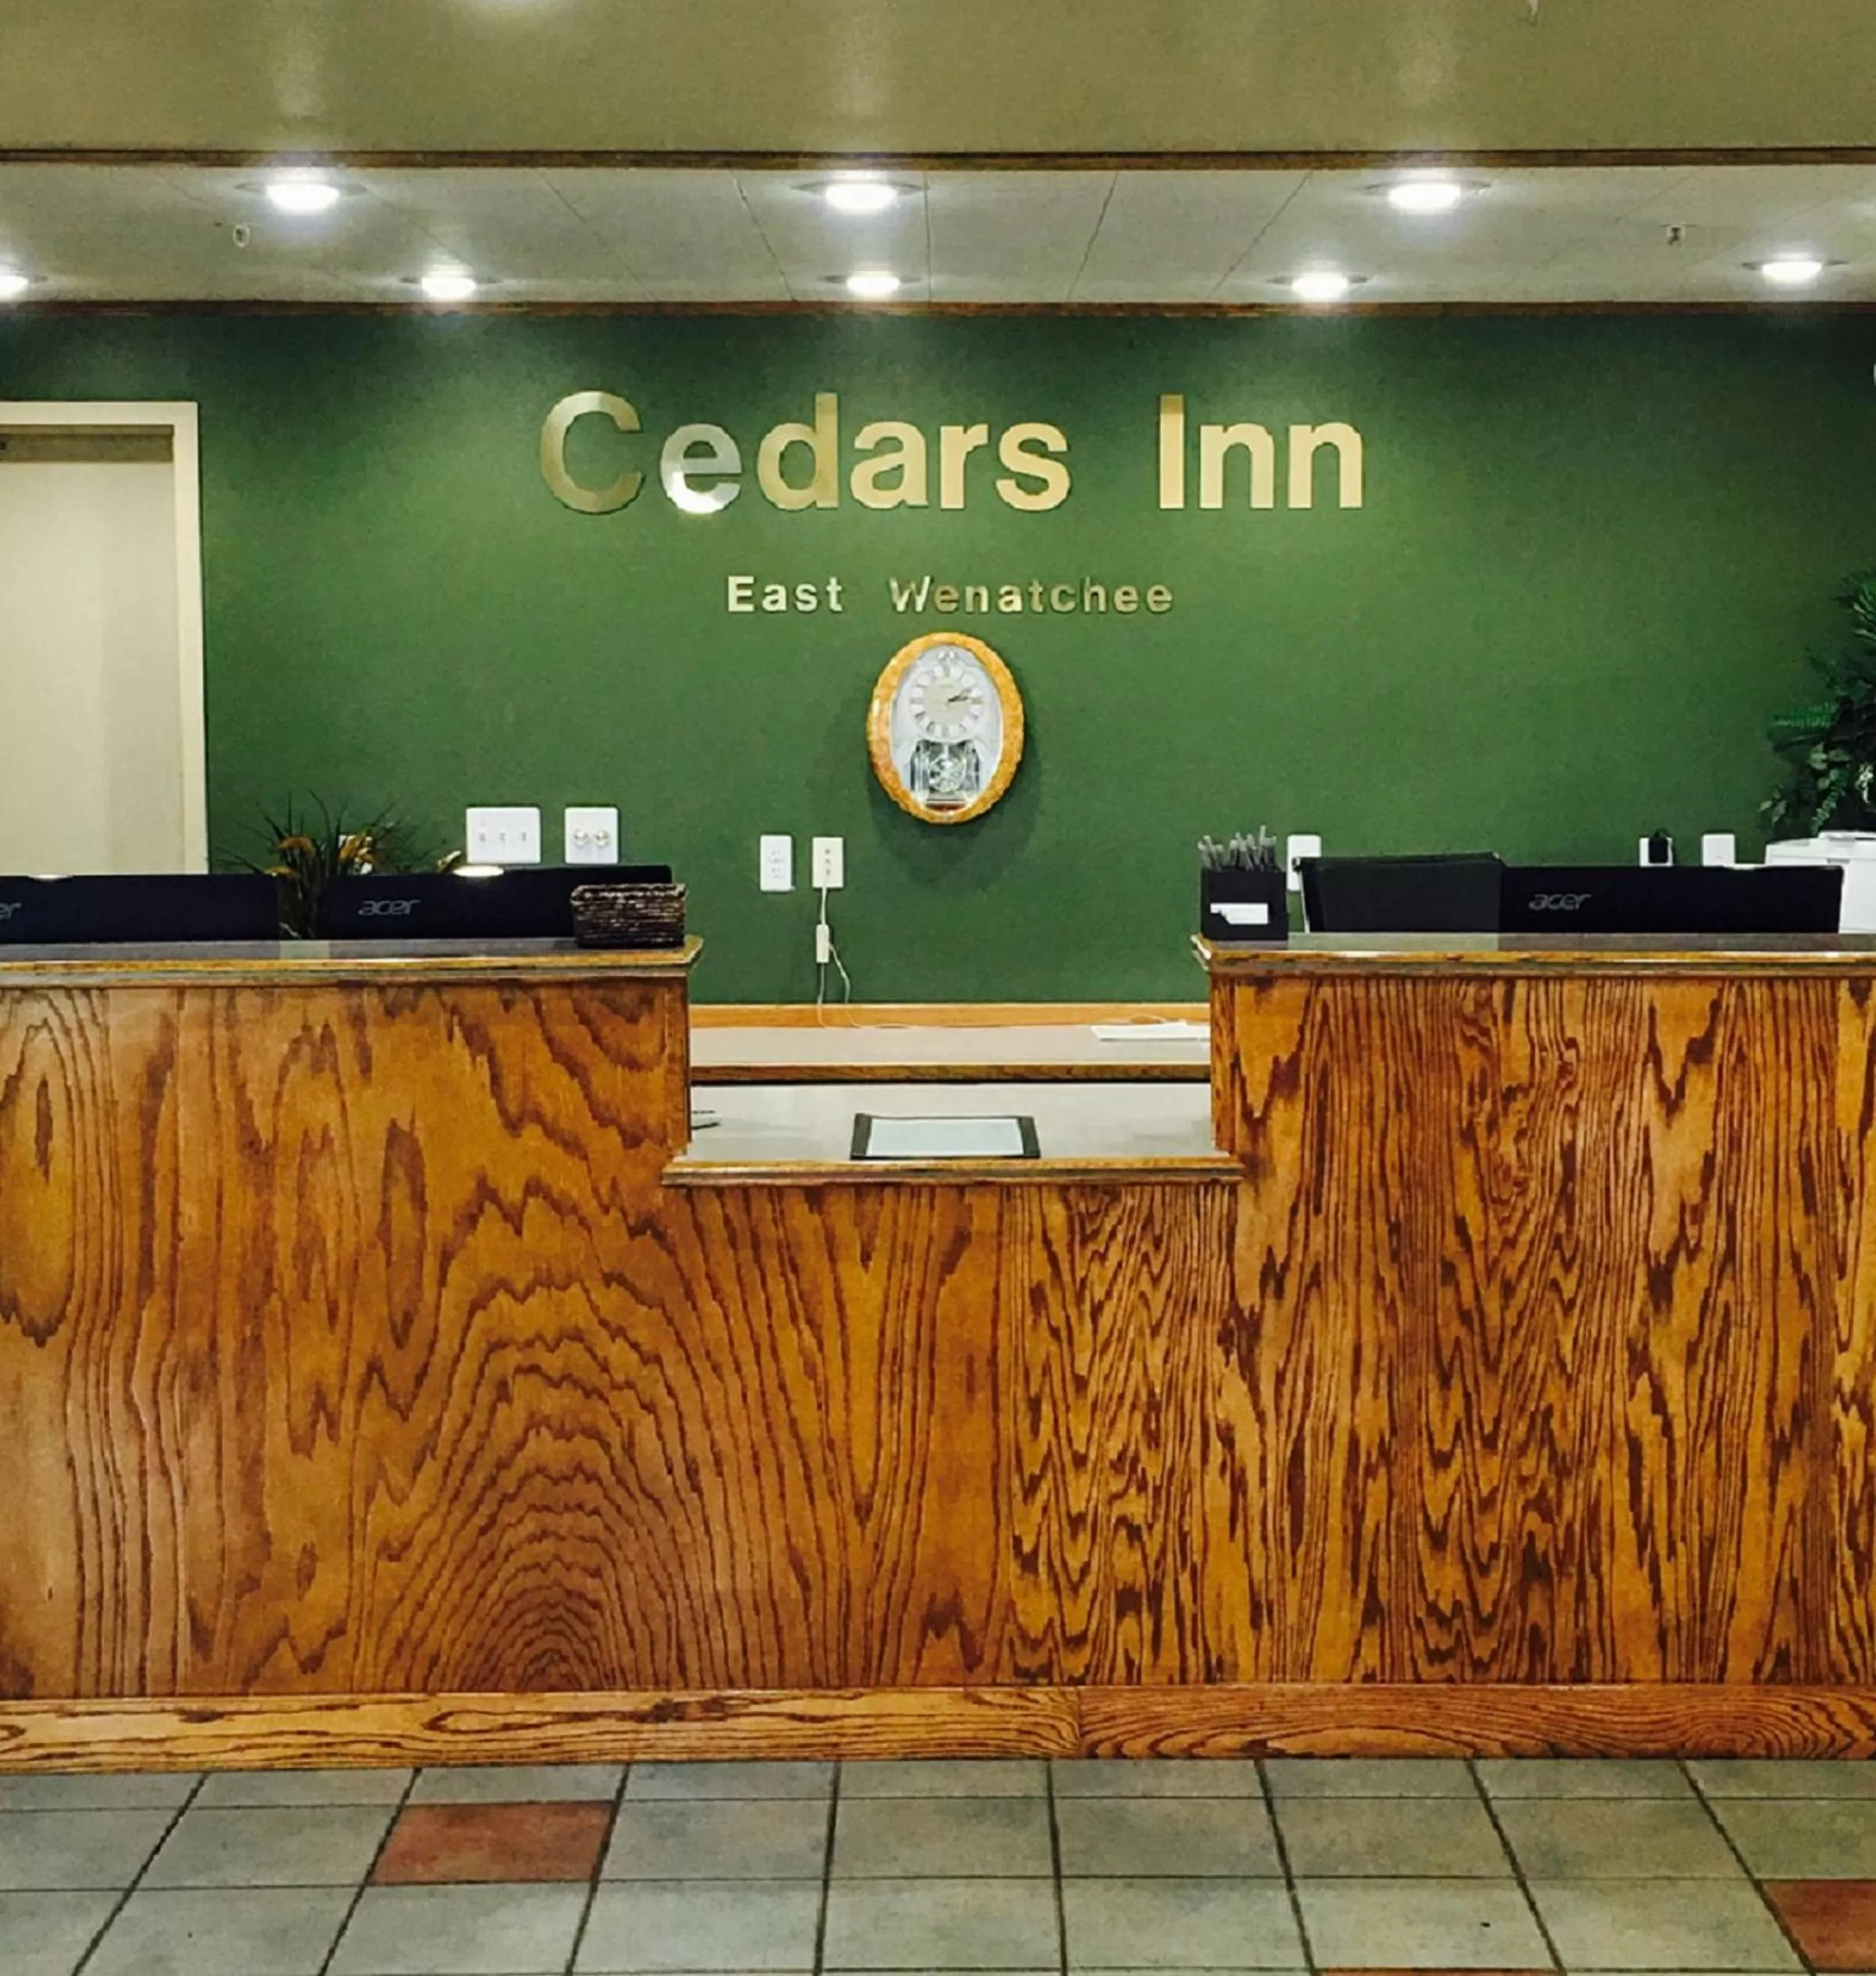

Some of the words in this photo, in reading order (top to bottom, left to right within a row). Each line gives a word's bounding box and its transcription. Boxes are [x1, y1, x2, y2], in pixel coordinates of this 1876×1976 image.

[540, 390, 1072, 513] Cedars
[1159, 393, 1364, 510] Inn
[727, 576, 843, 613] East
[888, 576, 1173, 614] Wenatchee
[358, 900, 421, 916] acer
[1529, 893, 1592, 910] acer
